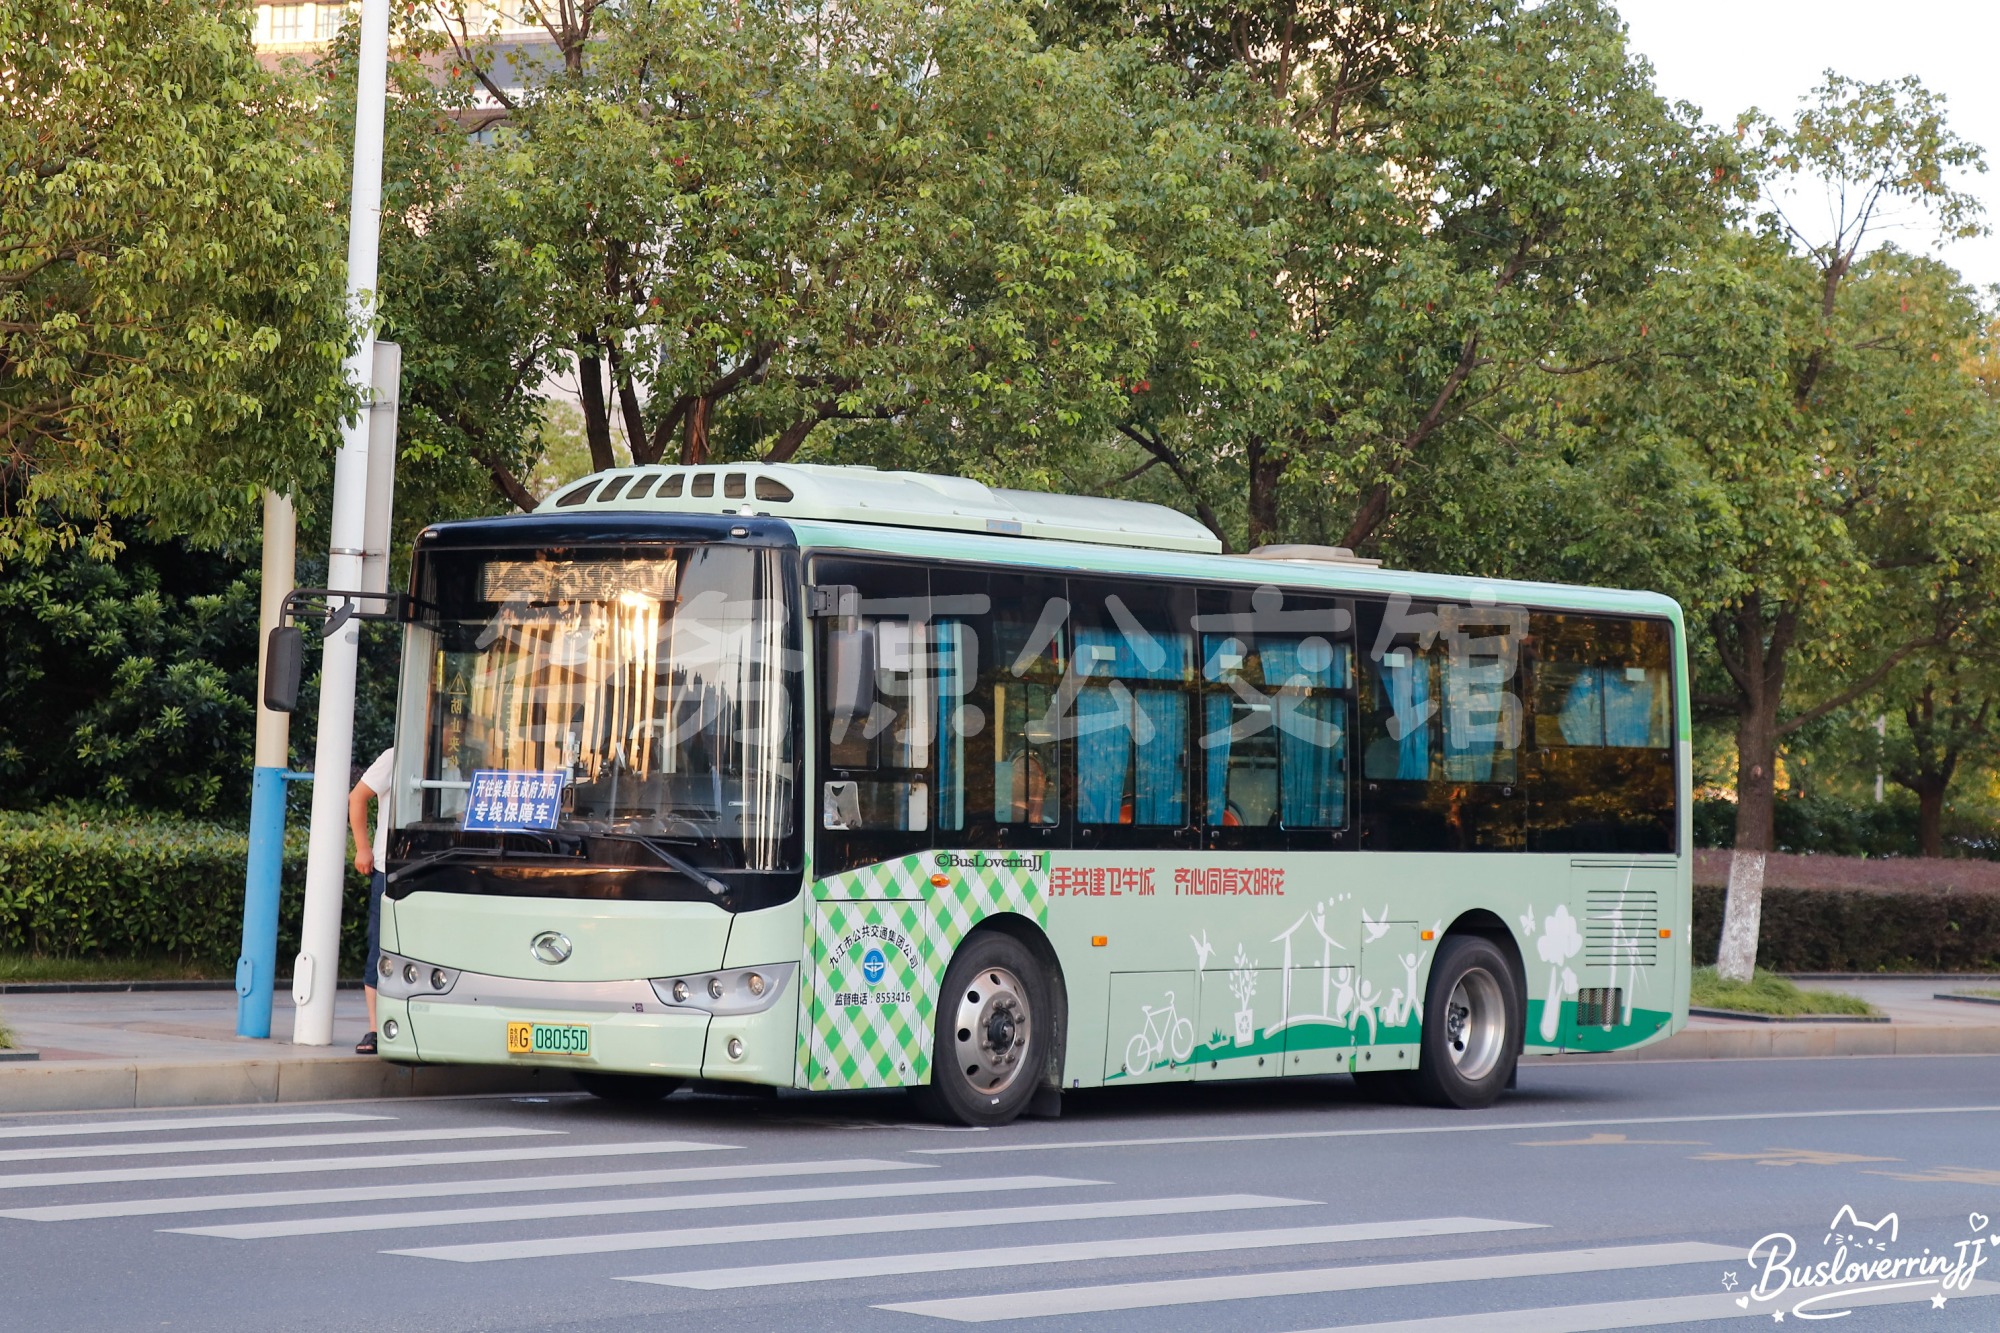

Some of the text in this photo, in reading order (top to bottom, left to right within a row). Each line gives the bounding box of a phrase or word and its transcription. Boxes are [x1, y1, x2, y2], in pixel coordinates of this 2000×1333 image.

[475, 779, 557, 799] 开往柴桑区政府方向
[474, 801, 549, 823] 专线保障车
[1174, 868, 1285, 895] 齐心同育文明花
[829, 925, 918, 969] 九江市公共交通集团公司
